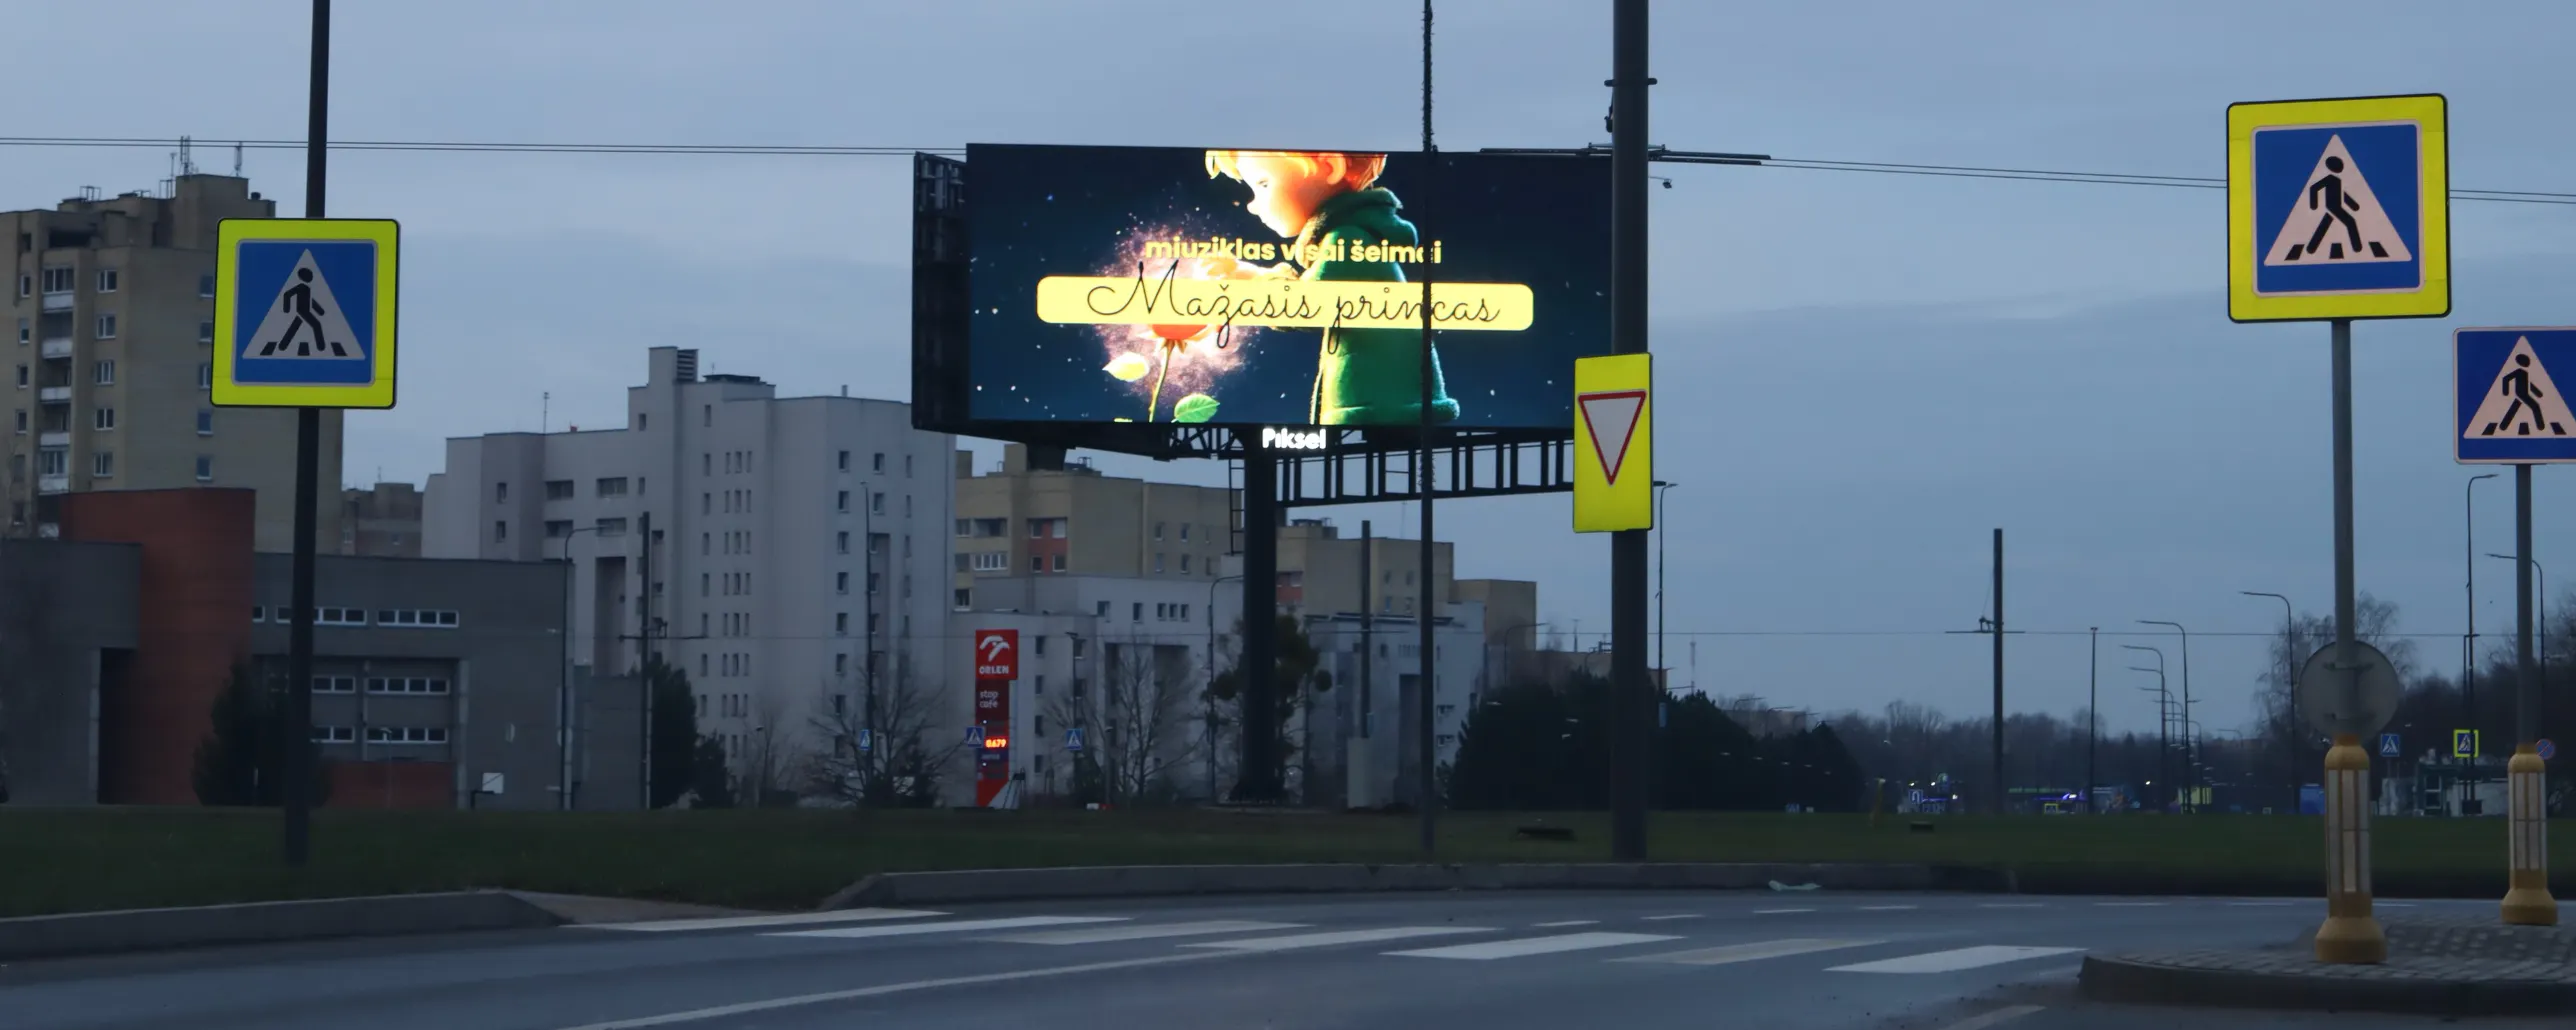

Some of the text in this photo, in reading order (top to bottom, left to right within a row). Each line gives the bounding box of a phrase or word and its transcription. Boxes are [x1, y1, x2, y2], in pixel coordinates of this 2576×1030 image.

[1145, 237, 1275, 262] miuziklas
[1280, 238, 1346, 263] visai
[1087, 259, 1500, 355] Mažasis princas
[1262, 427, 1327, 450] Piksel
[979, 665, 1009, 674] ORLEN
[980, 690, 999, 699] stop
[979, 700, 998, 709] cafe
